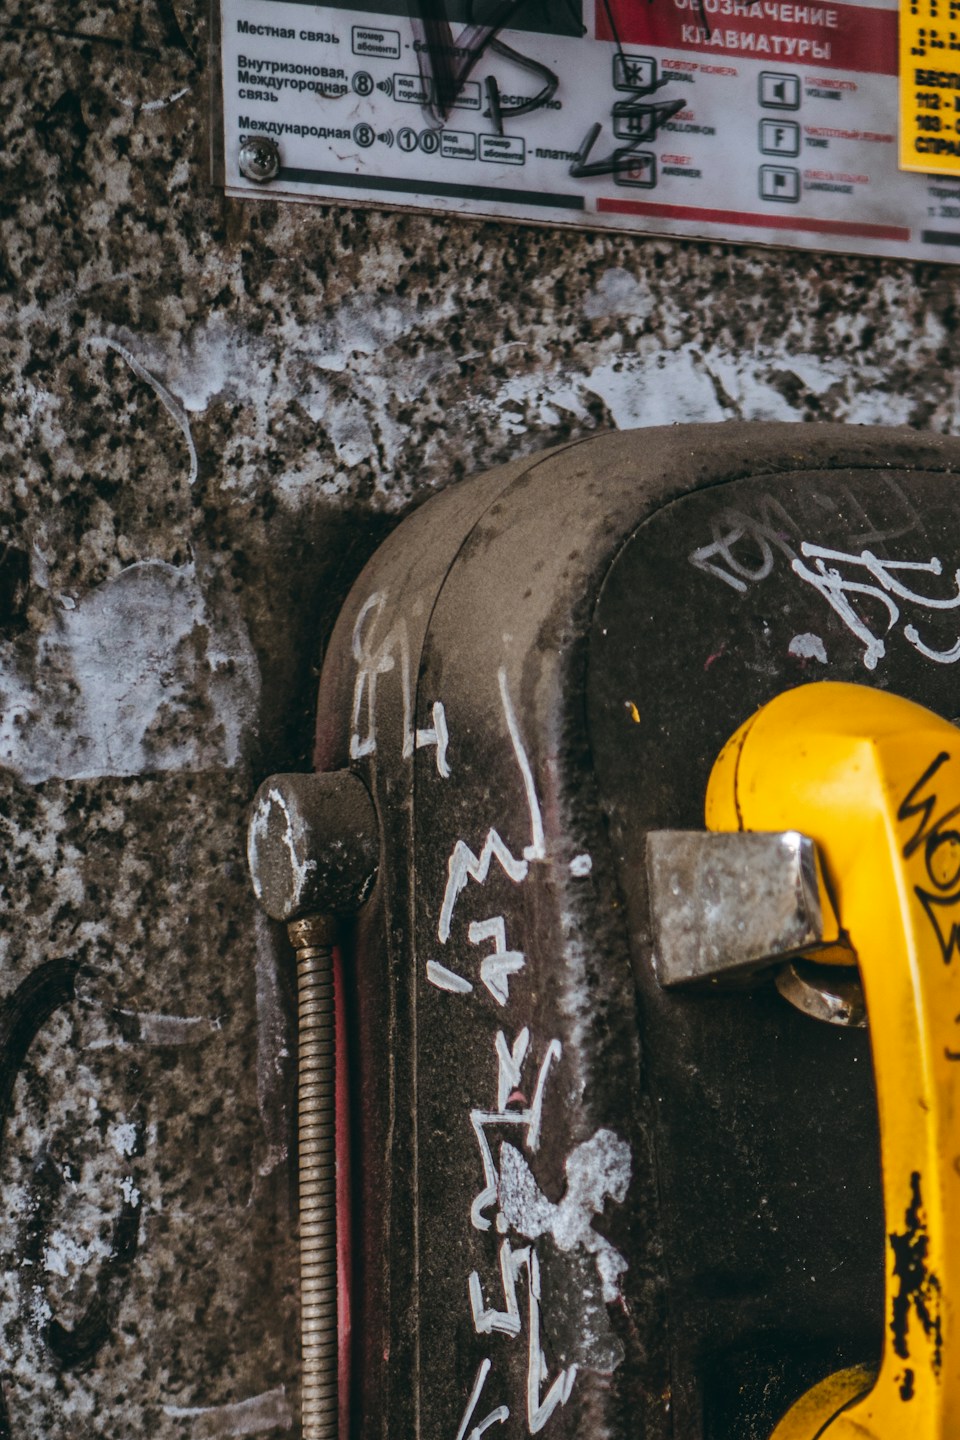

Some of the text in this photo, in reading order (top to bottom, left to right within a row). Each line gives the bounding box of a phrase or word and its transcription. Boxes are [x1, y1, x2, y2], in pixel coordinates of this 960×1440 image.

[237, 19, 340, 44] Местная связь
[357, 32, 384, 43] номер
[357, 42, 397, 54] абонента
[681, 23, 832, 60] КЛАВИАТУРЫ
[237, 54, 349, 82] Внутризоновая,
[237, 70, 348, 95] Междугородная
[661, 70, 696, 83] REDIAL
[398, 79, 414, 89] код
[238, 88, 278, 102] связь
[238, 116, 351, 140] Международная
[443, 135, 458, 144] код
